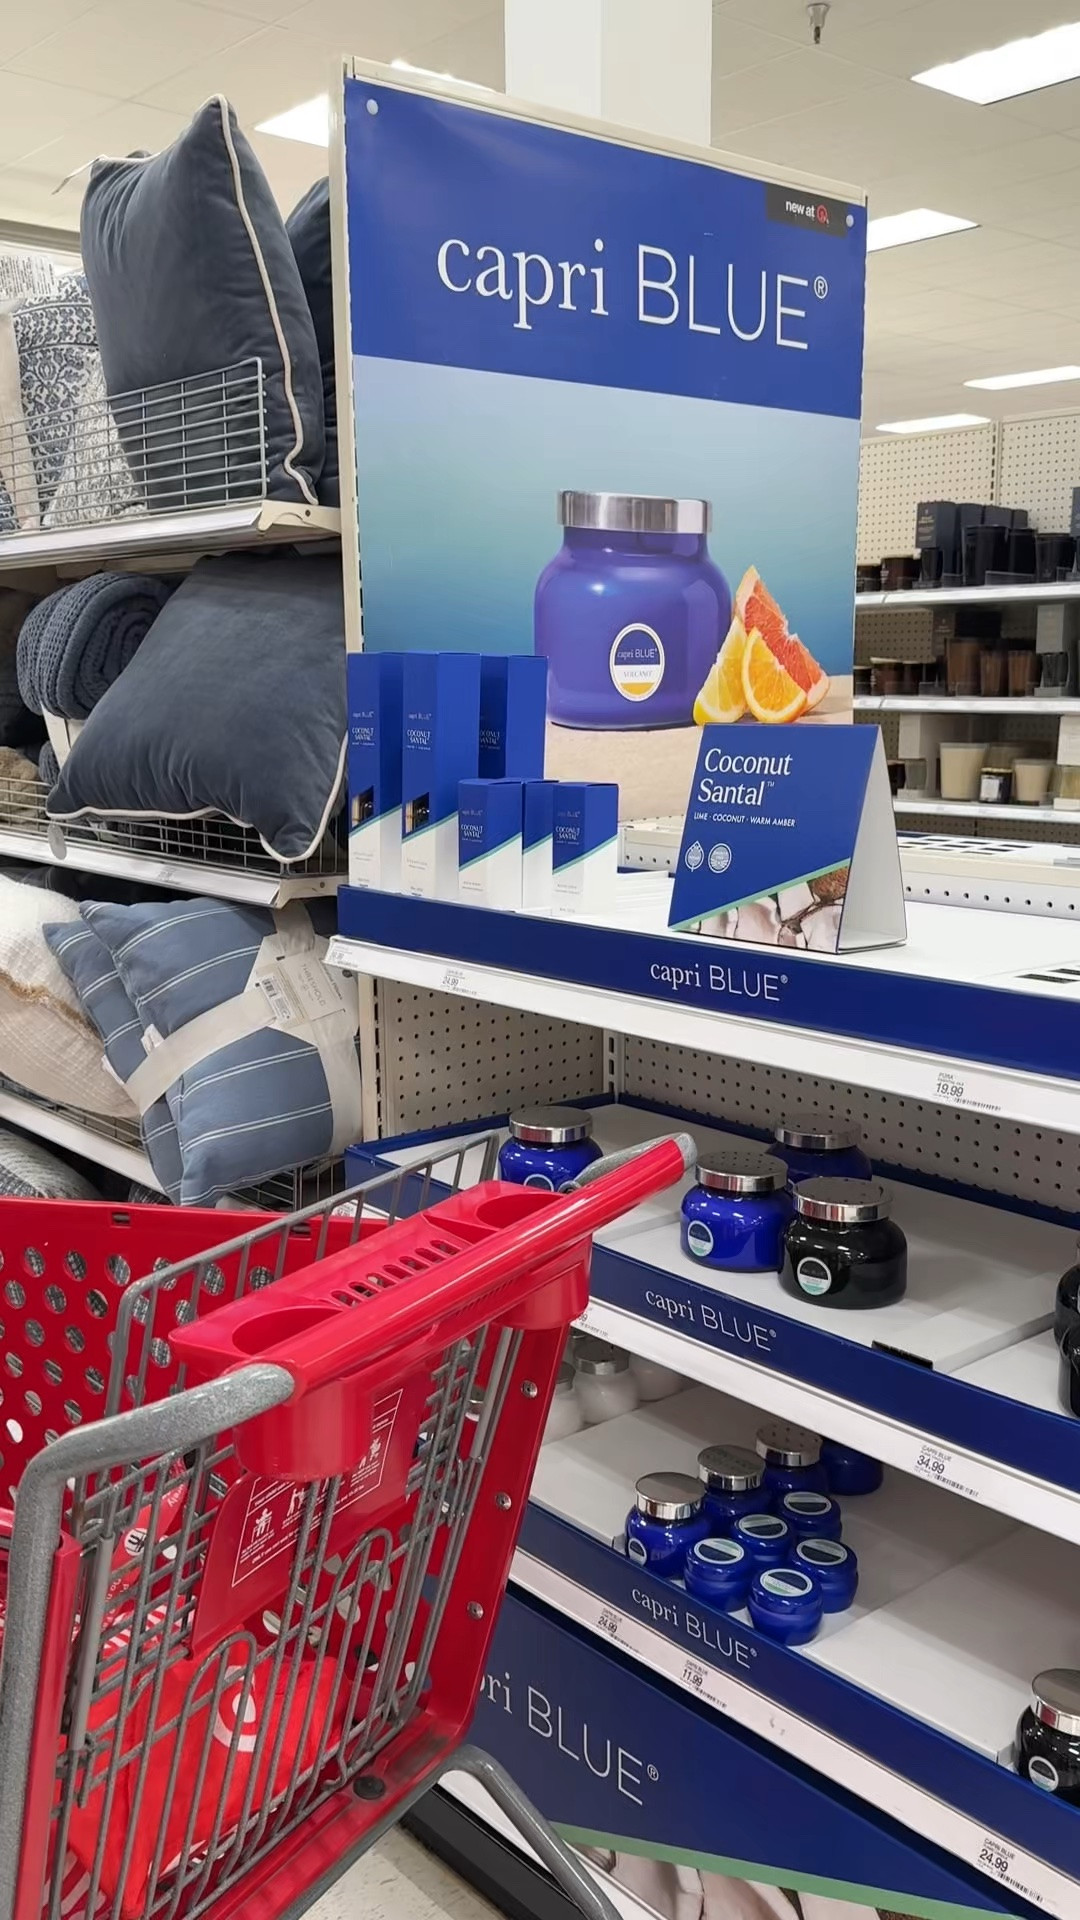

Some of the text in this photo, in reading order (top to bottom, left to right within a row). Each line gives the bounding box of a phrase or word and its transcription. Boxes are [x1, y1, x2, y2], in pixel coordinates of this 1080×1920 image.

[785, 200, 816, 218] new at
[437, 238, 609, 330] capri
[352, 727, 374, 737] COCONUT
[406, 729, 431, 741] COCONUT
[409, 736, 428, 745] SANTAL
[480, 730, 500, 740] OCONUT
[704, 748, 793, 776] Coconut
[693, 812, 796, 827] LIME COCONUT WARM AMBER
[460, 824, 483, 834] COCONUT
[555, 825, 580, 836] COCONUT
[558, 832, 577, 840] SANTAL
[442, 975, 459, 987] 24.99
[649, 962, 701, 991] capri
[936, 1082, 964, 1098] 19.99
[645, 1289, 695, 1322] capri
[921, 1445, 937, 1456] CAPRI
[937, 1451, 952, 1461] BLUE
[917, 1455, 945, 1475] 34.99
[632, 1588, 678, 1626] capri
[597, 1616, 618, 1634] 24.99
[682, 1669, 704, 1687] 11.99
[984, 1838, 1016, 1860] CAPRI BLUE
[979, 1848, 1009, 1873] 24.99
